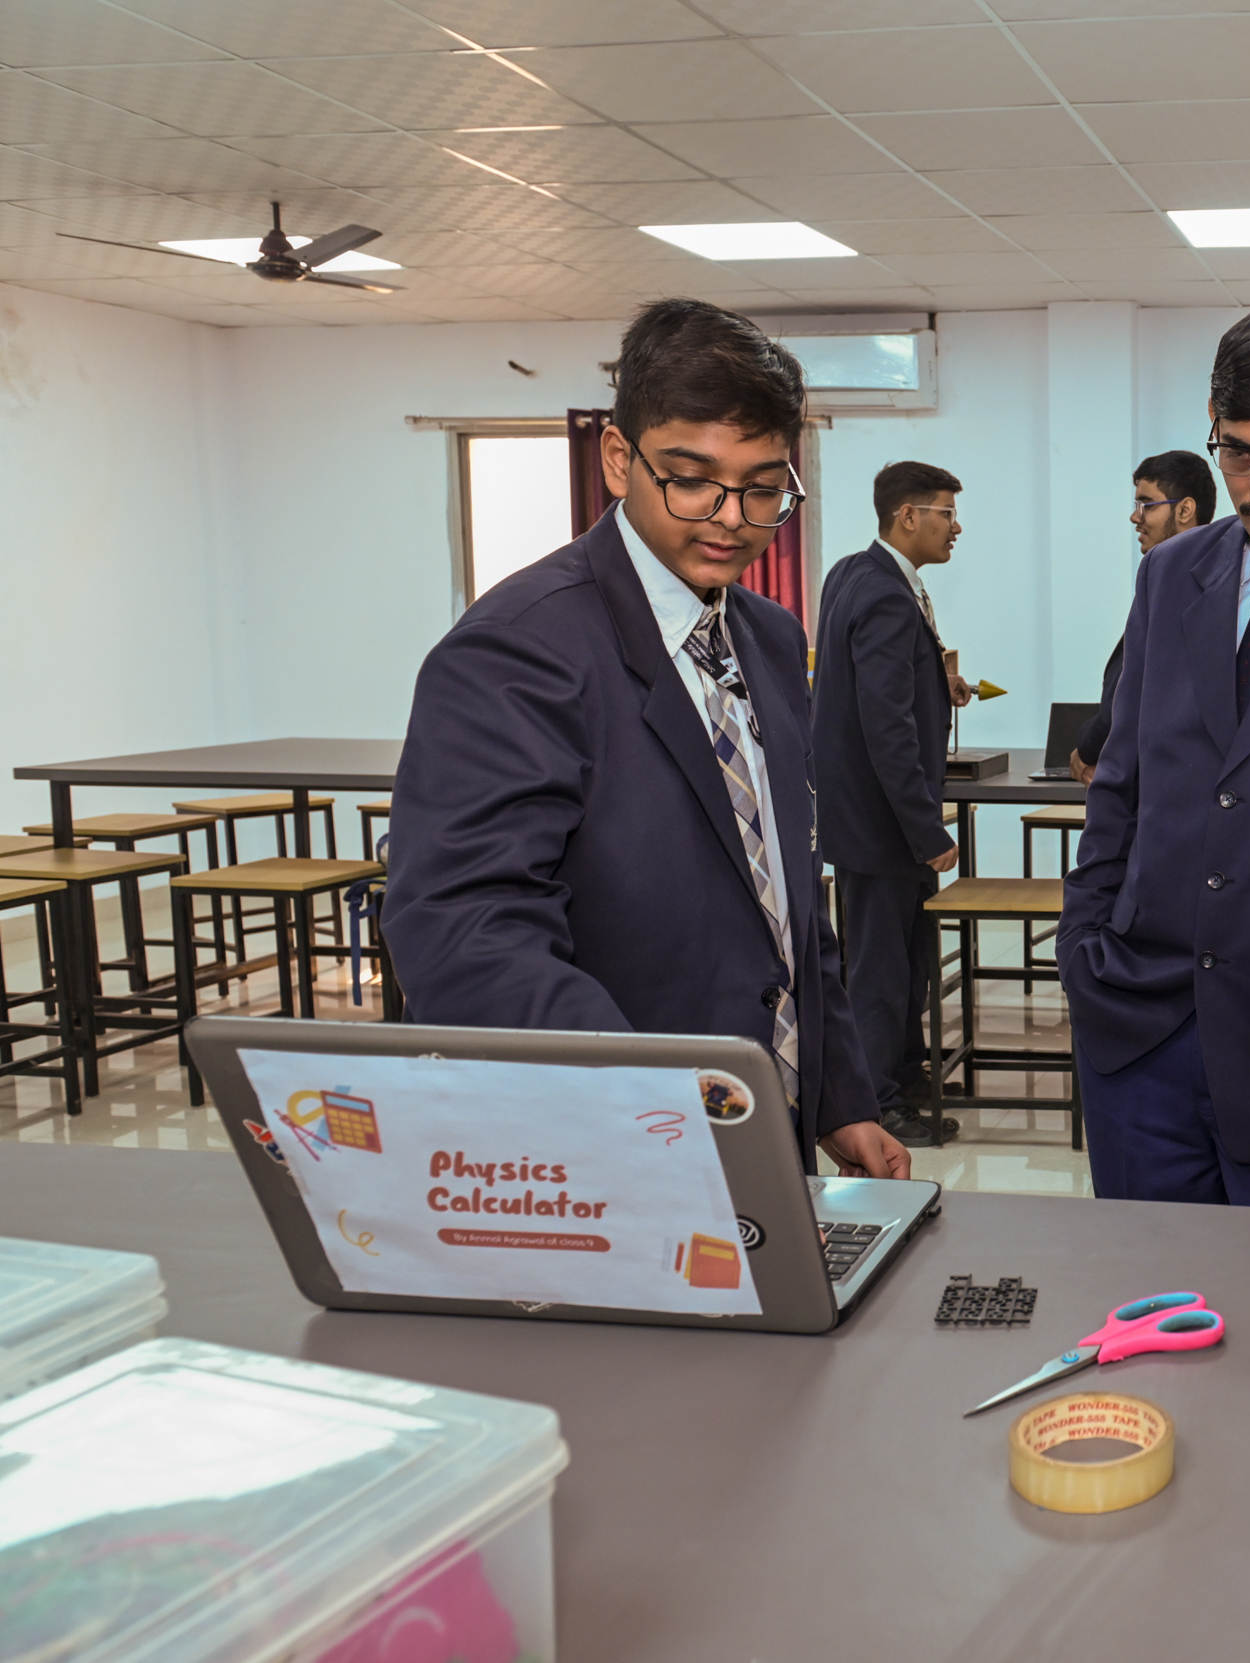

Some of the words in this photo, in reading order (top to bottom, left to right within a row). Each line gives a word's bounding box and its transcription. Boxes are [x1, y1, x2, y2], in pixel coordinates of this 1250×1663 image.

[429, 1150, 567, 1187] Physics
[427, 1186, 607, 1219] Calculator
[453, 1232, 468, 1243] By
[469, 1233, 501, 1243] Anmol
[503, 1235, 545, 1246] Agrawal
[547, 1237, 558, 1245] of
[559, 1237, 585, 1247] class
[1033, 1408, 1057, 1427] TAPE
[1068, 1401, 1140, 1416] WONDER-555
[1037, 1414, 1107, 1437] WONDER-555
[1112, 1414, 1140, 1428] TAPE
[1068, 1426, 1140, 1443] WONDER-555
